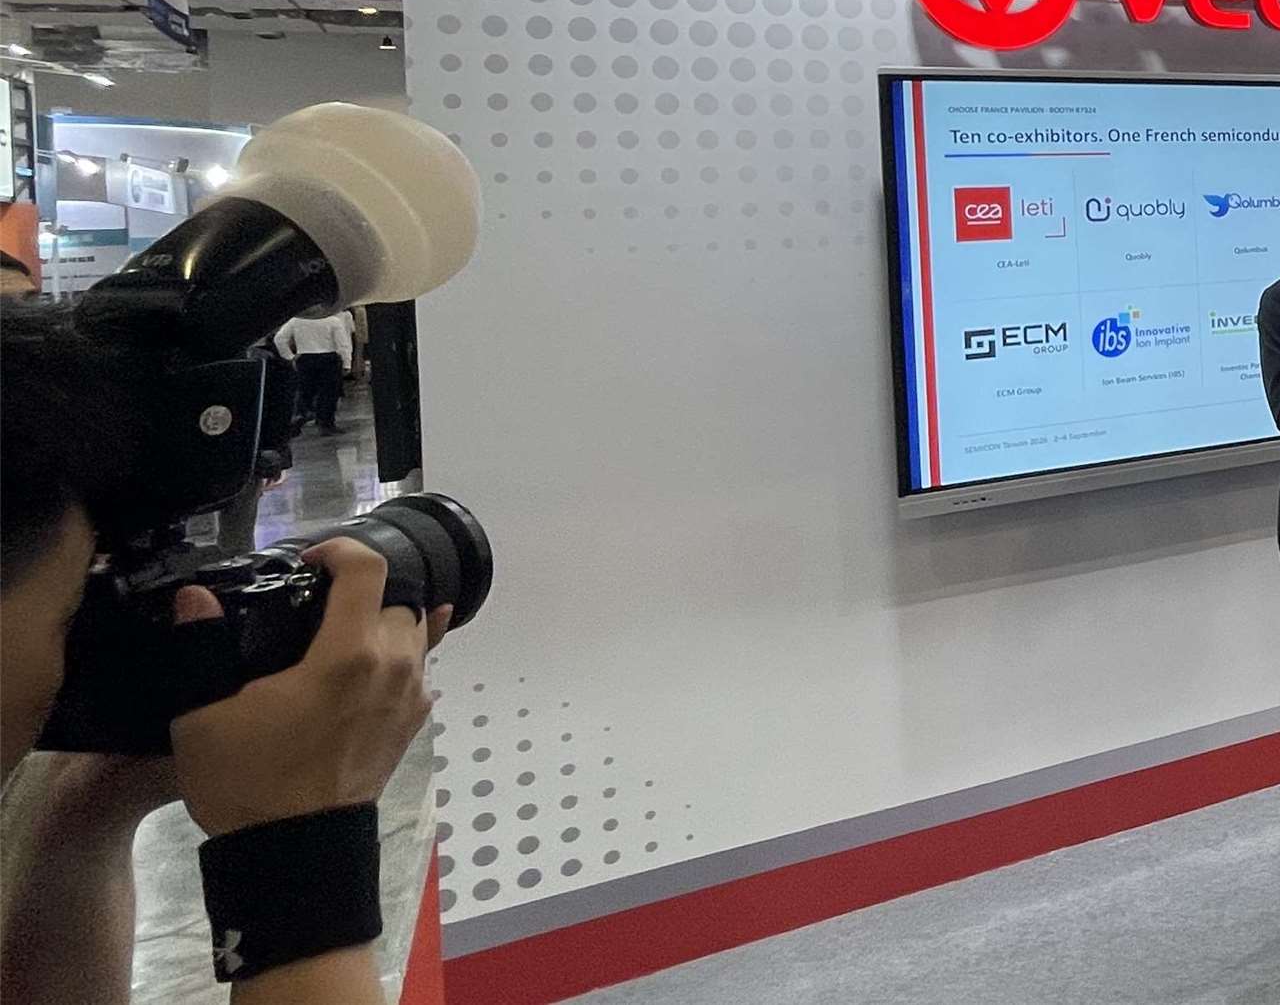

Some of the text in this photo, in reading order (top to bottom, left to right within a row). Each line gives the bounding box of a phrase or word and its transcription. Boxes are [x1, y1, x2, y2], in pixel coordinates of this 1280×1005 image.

[948, 106, 979, 114] CHOOSE
[981, 106, 1009, 114] FRANCE
[1010, 106, 1044, 114] PAVILION
[950, 129, 981, 144] Ten
[987, 128, 1103, 144] co-exhibitors.
[1108, 129, 1141, 142] One
[1146, 128, 1196, 143] French
[965, 198, 1053, 220] cea leti
[1116, 198, 1186, 221] quobly
[1124, 252, 1152, 262] Quobly
[996, 259, 1030, 269] CEA-Leti
[1002, 322, 1067, 347] ECM
[1135, 325, 1191, 337] Innovative
[1135, 335, 1191, 348] Ion Implant
[1033, 344, 1069, 355] GROUP
[1116, 375, 1136, 385] Beam
[1138, 373, 1167, 383] Services
[996, 387, 1042, 398] ECM Group
